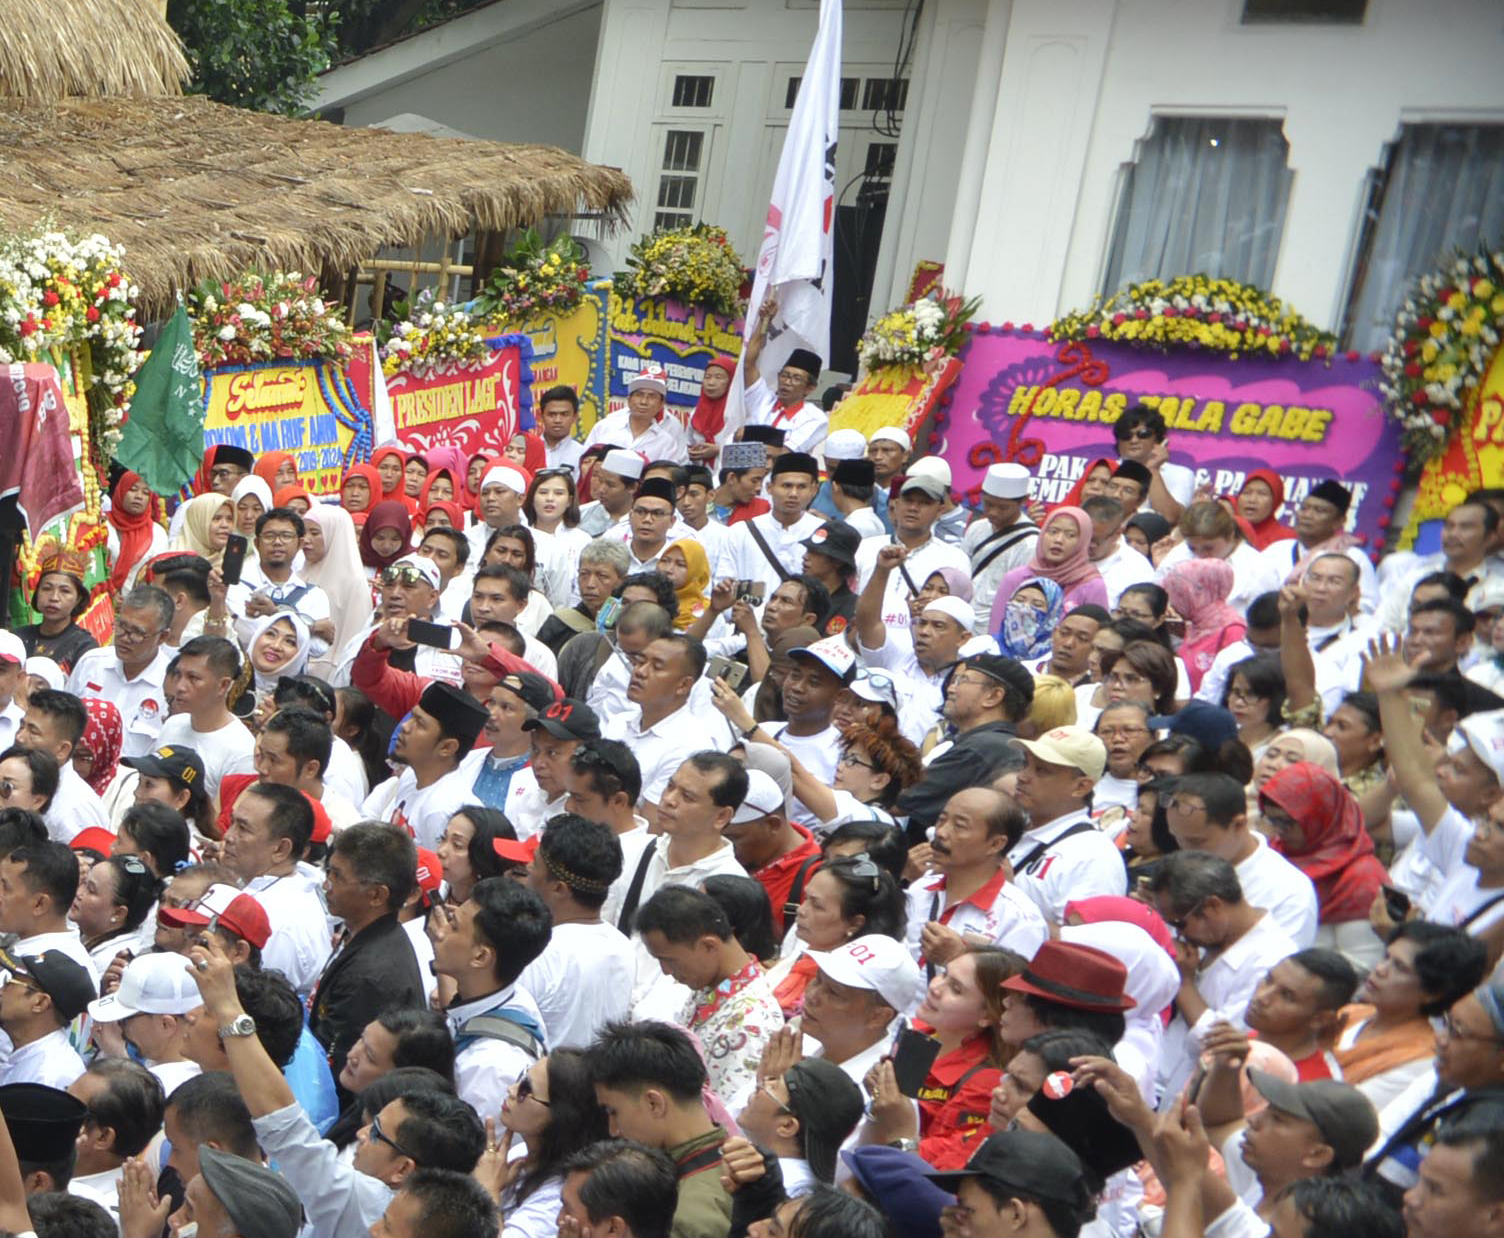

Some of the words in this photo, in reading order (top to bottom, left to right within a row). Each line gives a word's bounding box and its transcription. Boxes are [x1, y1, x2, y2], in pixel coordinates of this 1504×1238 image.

[396, 382, 464, 429] PRESIDEN
[1007, 385, 1127, 424] HORAS
[1229, 403, 1333, 441] GABE
[1038, 454, 1088, 479] PAK
[1213, 469, 1246, 497] PA
[546, 701, 574, 722] 01
